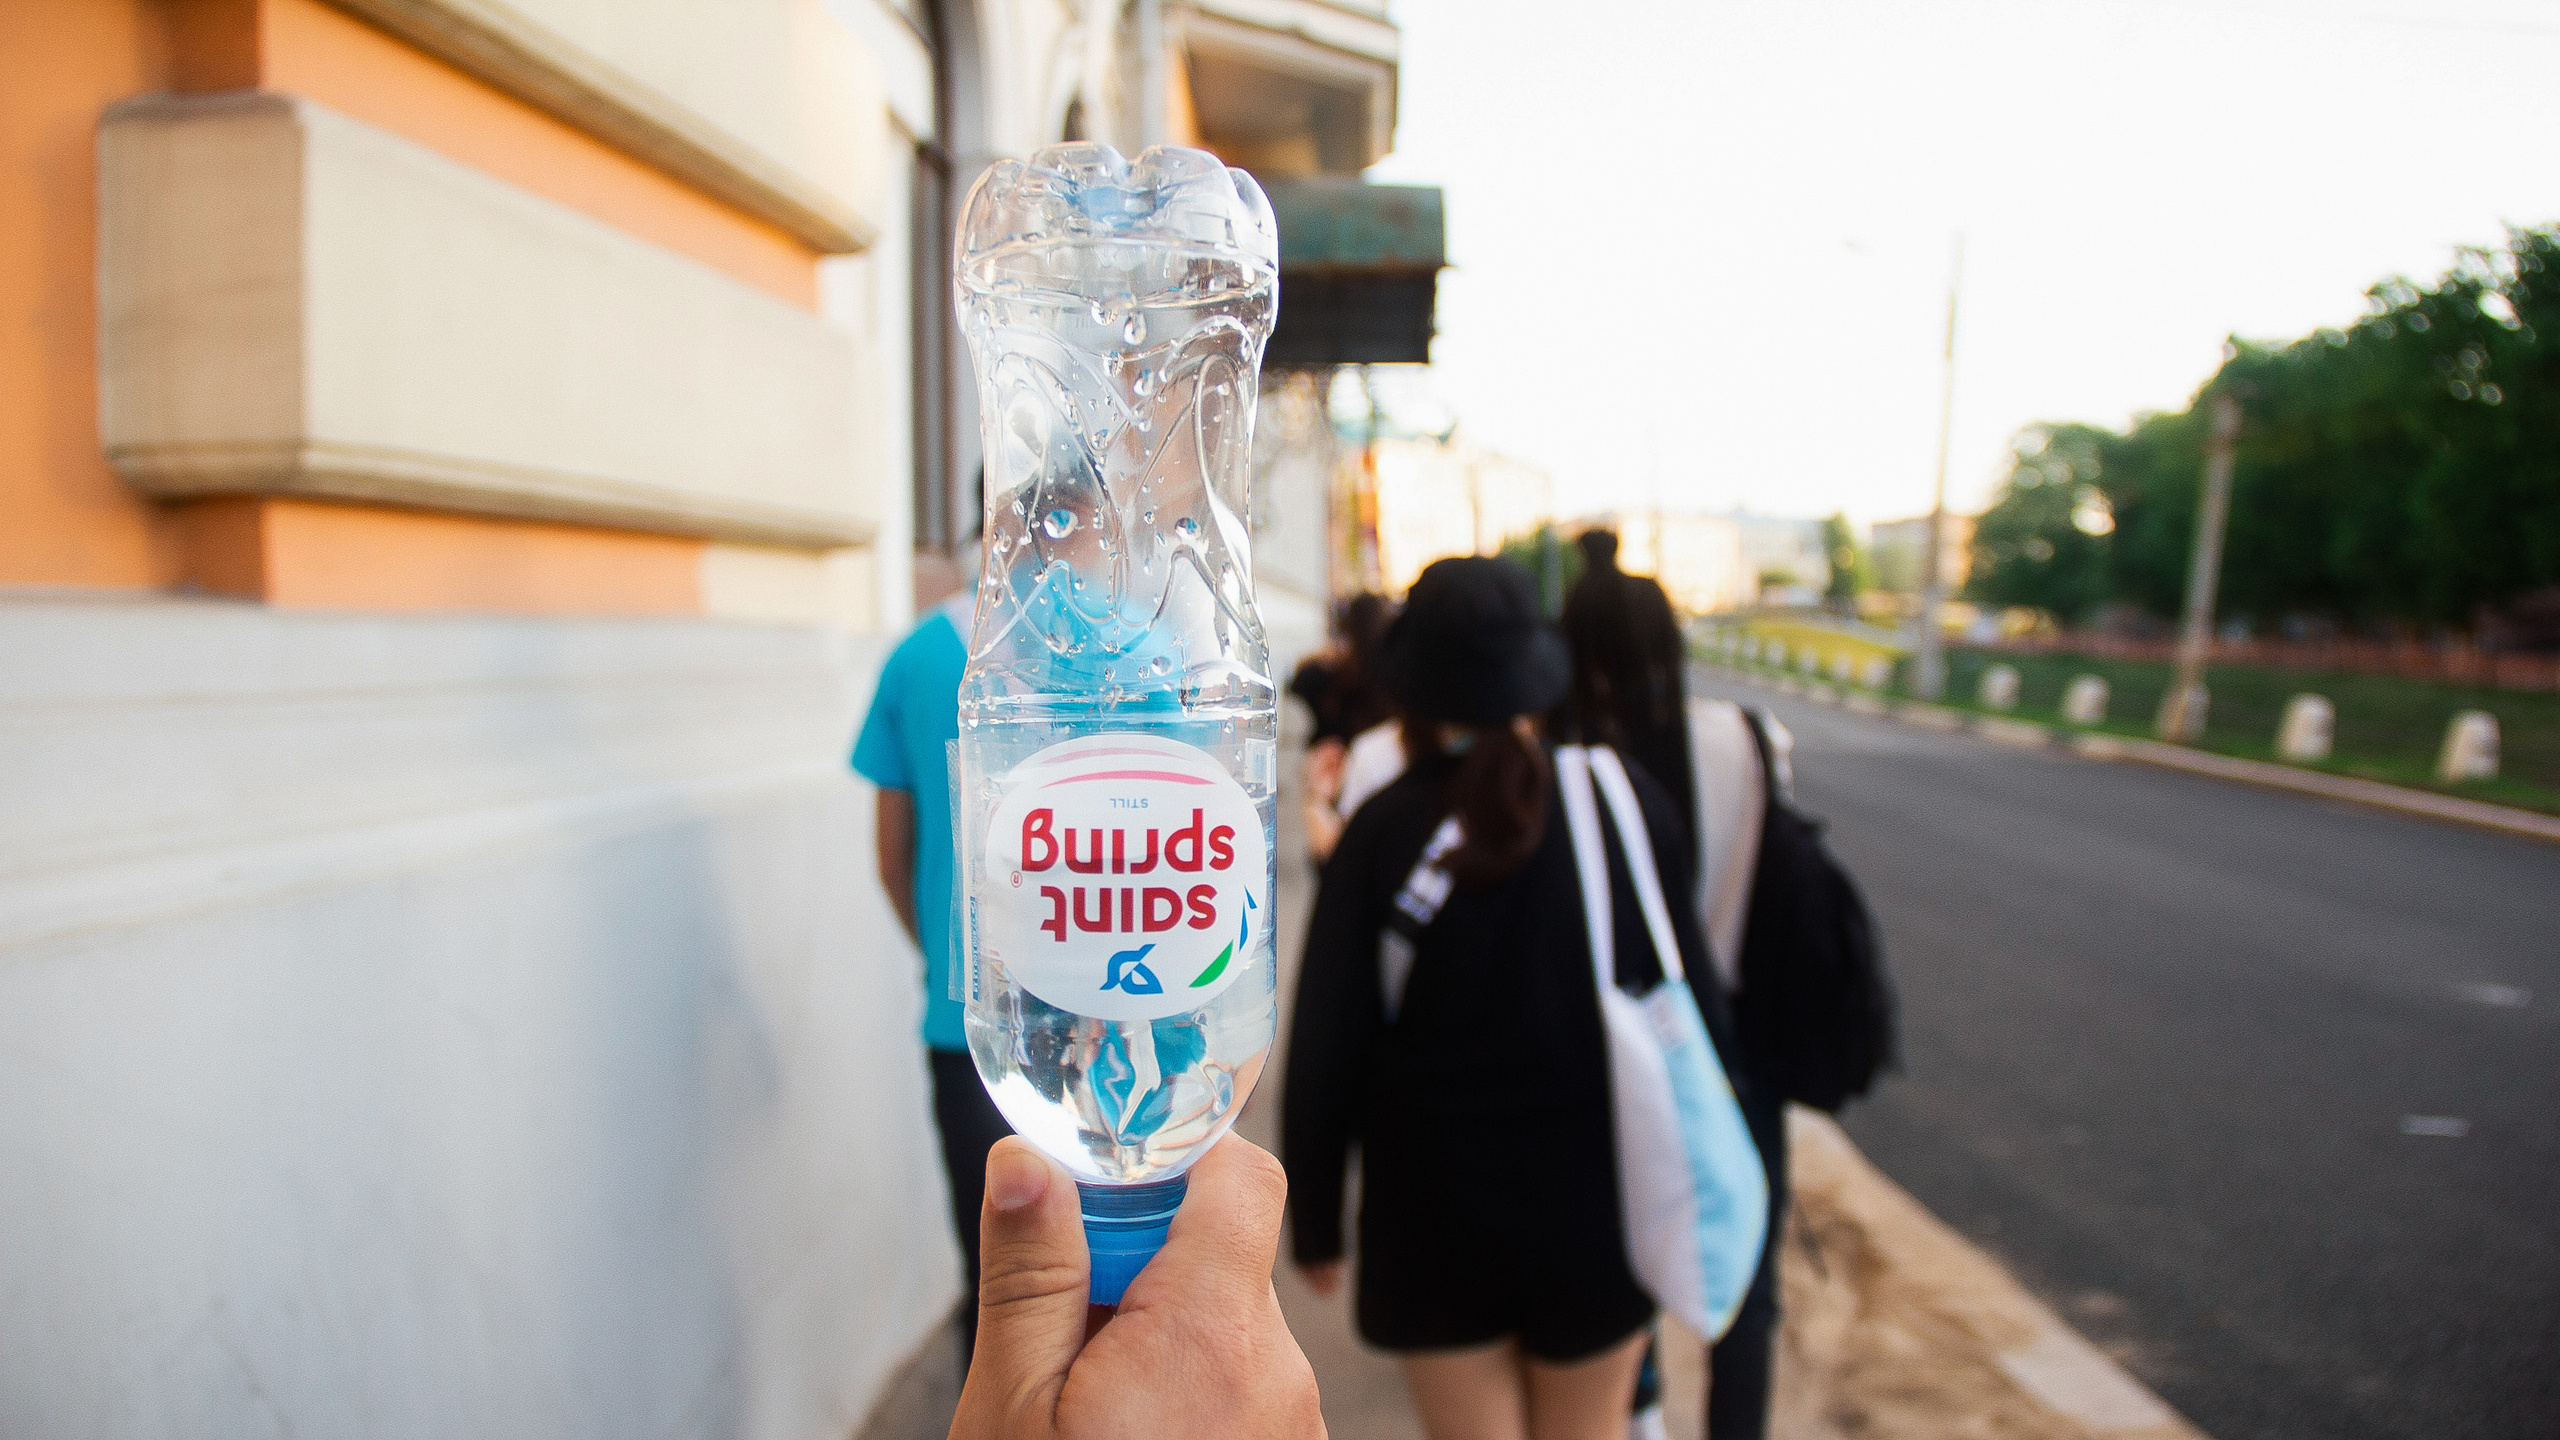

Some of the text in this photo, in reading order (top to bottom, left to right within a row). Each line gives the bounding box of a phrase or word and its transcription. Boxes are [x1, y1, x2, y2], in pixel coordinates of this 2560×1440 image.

[1109, 797, 1149, 809] STILL
[1021, 807, 1236, 874] spring
[1040, 883, 1217, 942] saint
